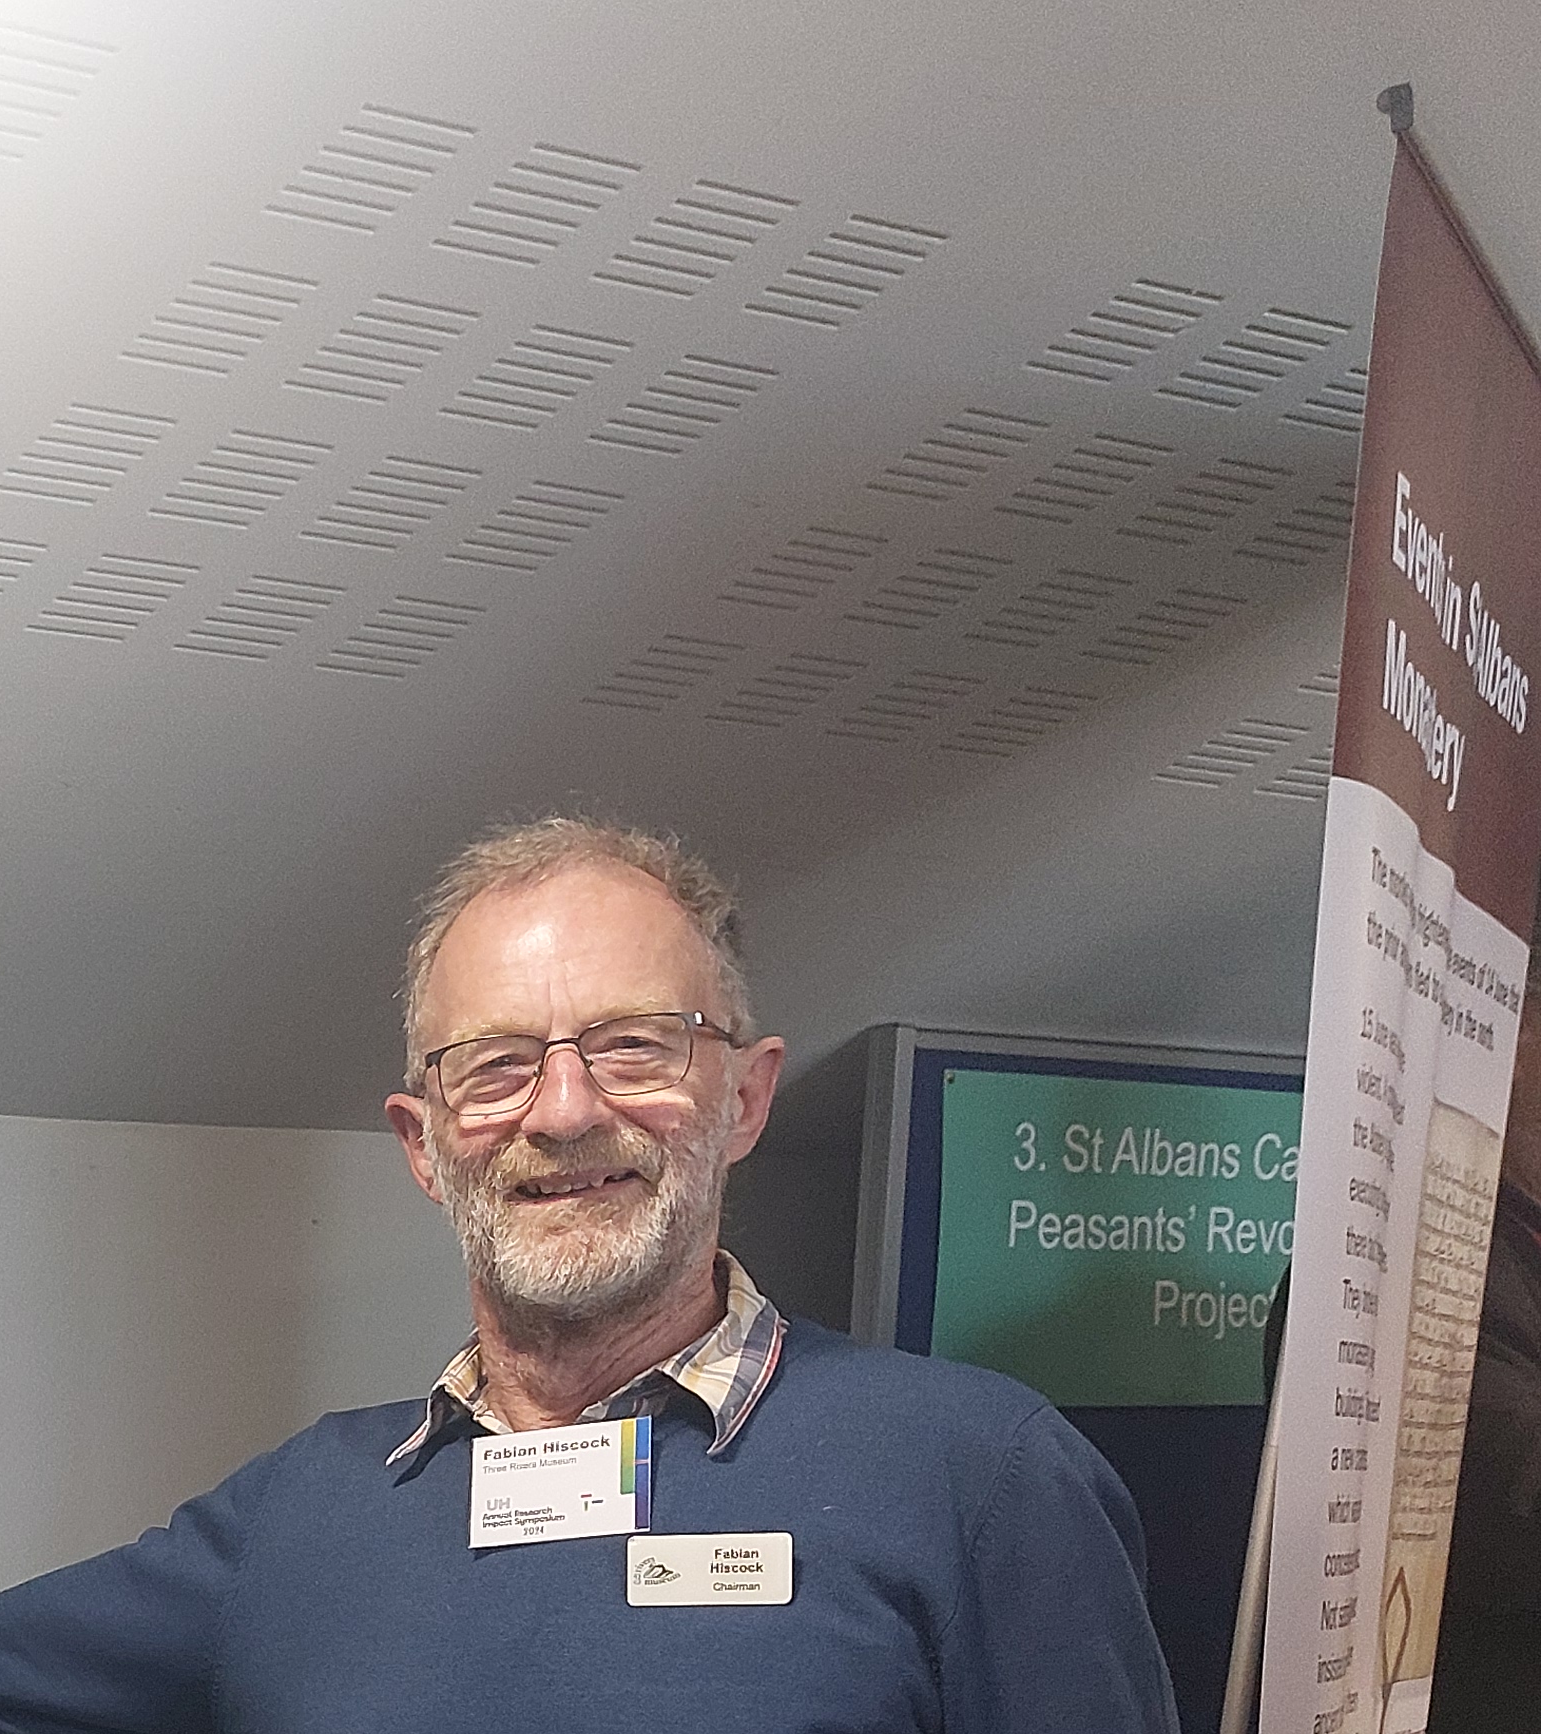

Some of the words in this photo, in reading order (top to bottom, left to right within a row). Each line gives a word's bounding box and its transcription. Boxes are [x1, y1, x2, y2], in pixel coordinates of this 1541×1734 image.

[1014, 1122, 1046, 1171] 3.
[1063, 1124, 1104, 1173] St
[1111, 1127, 1241, 1179] Albans
[1009, 1200, 1196, 1252] Peasants'
[483, 1447, 537, 1461] Fabian
[543, 1435, 611, 1455] Hiscock
[714, 1549, 759, 1560] Fabian
[710, 1562, 764, 1574] Hiscock
[713, 1582, 761, 1591] Chairman
